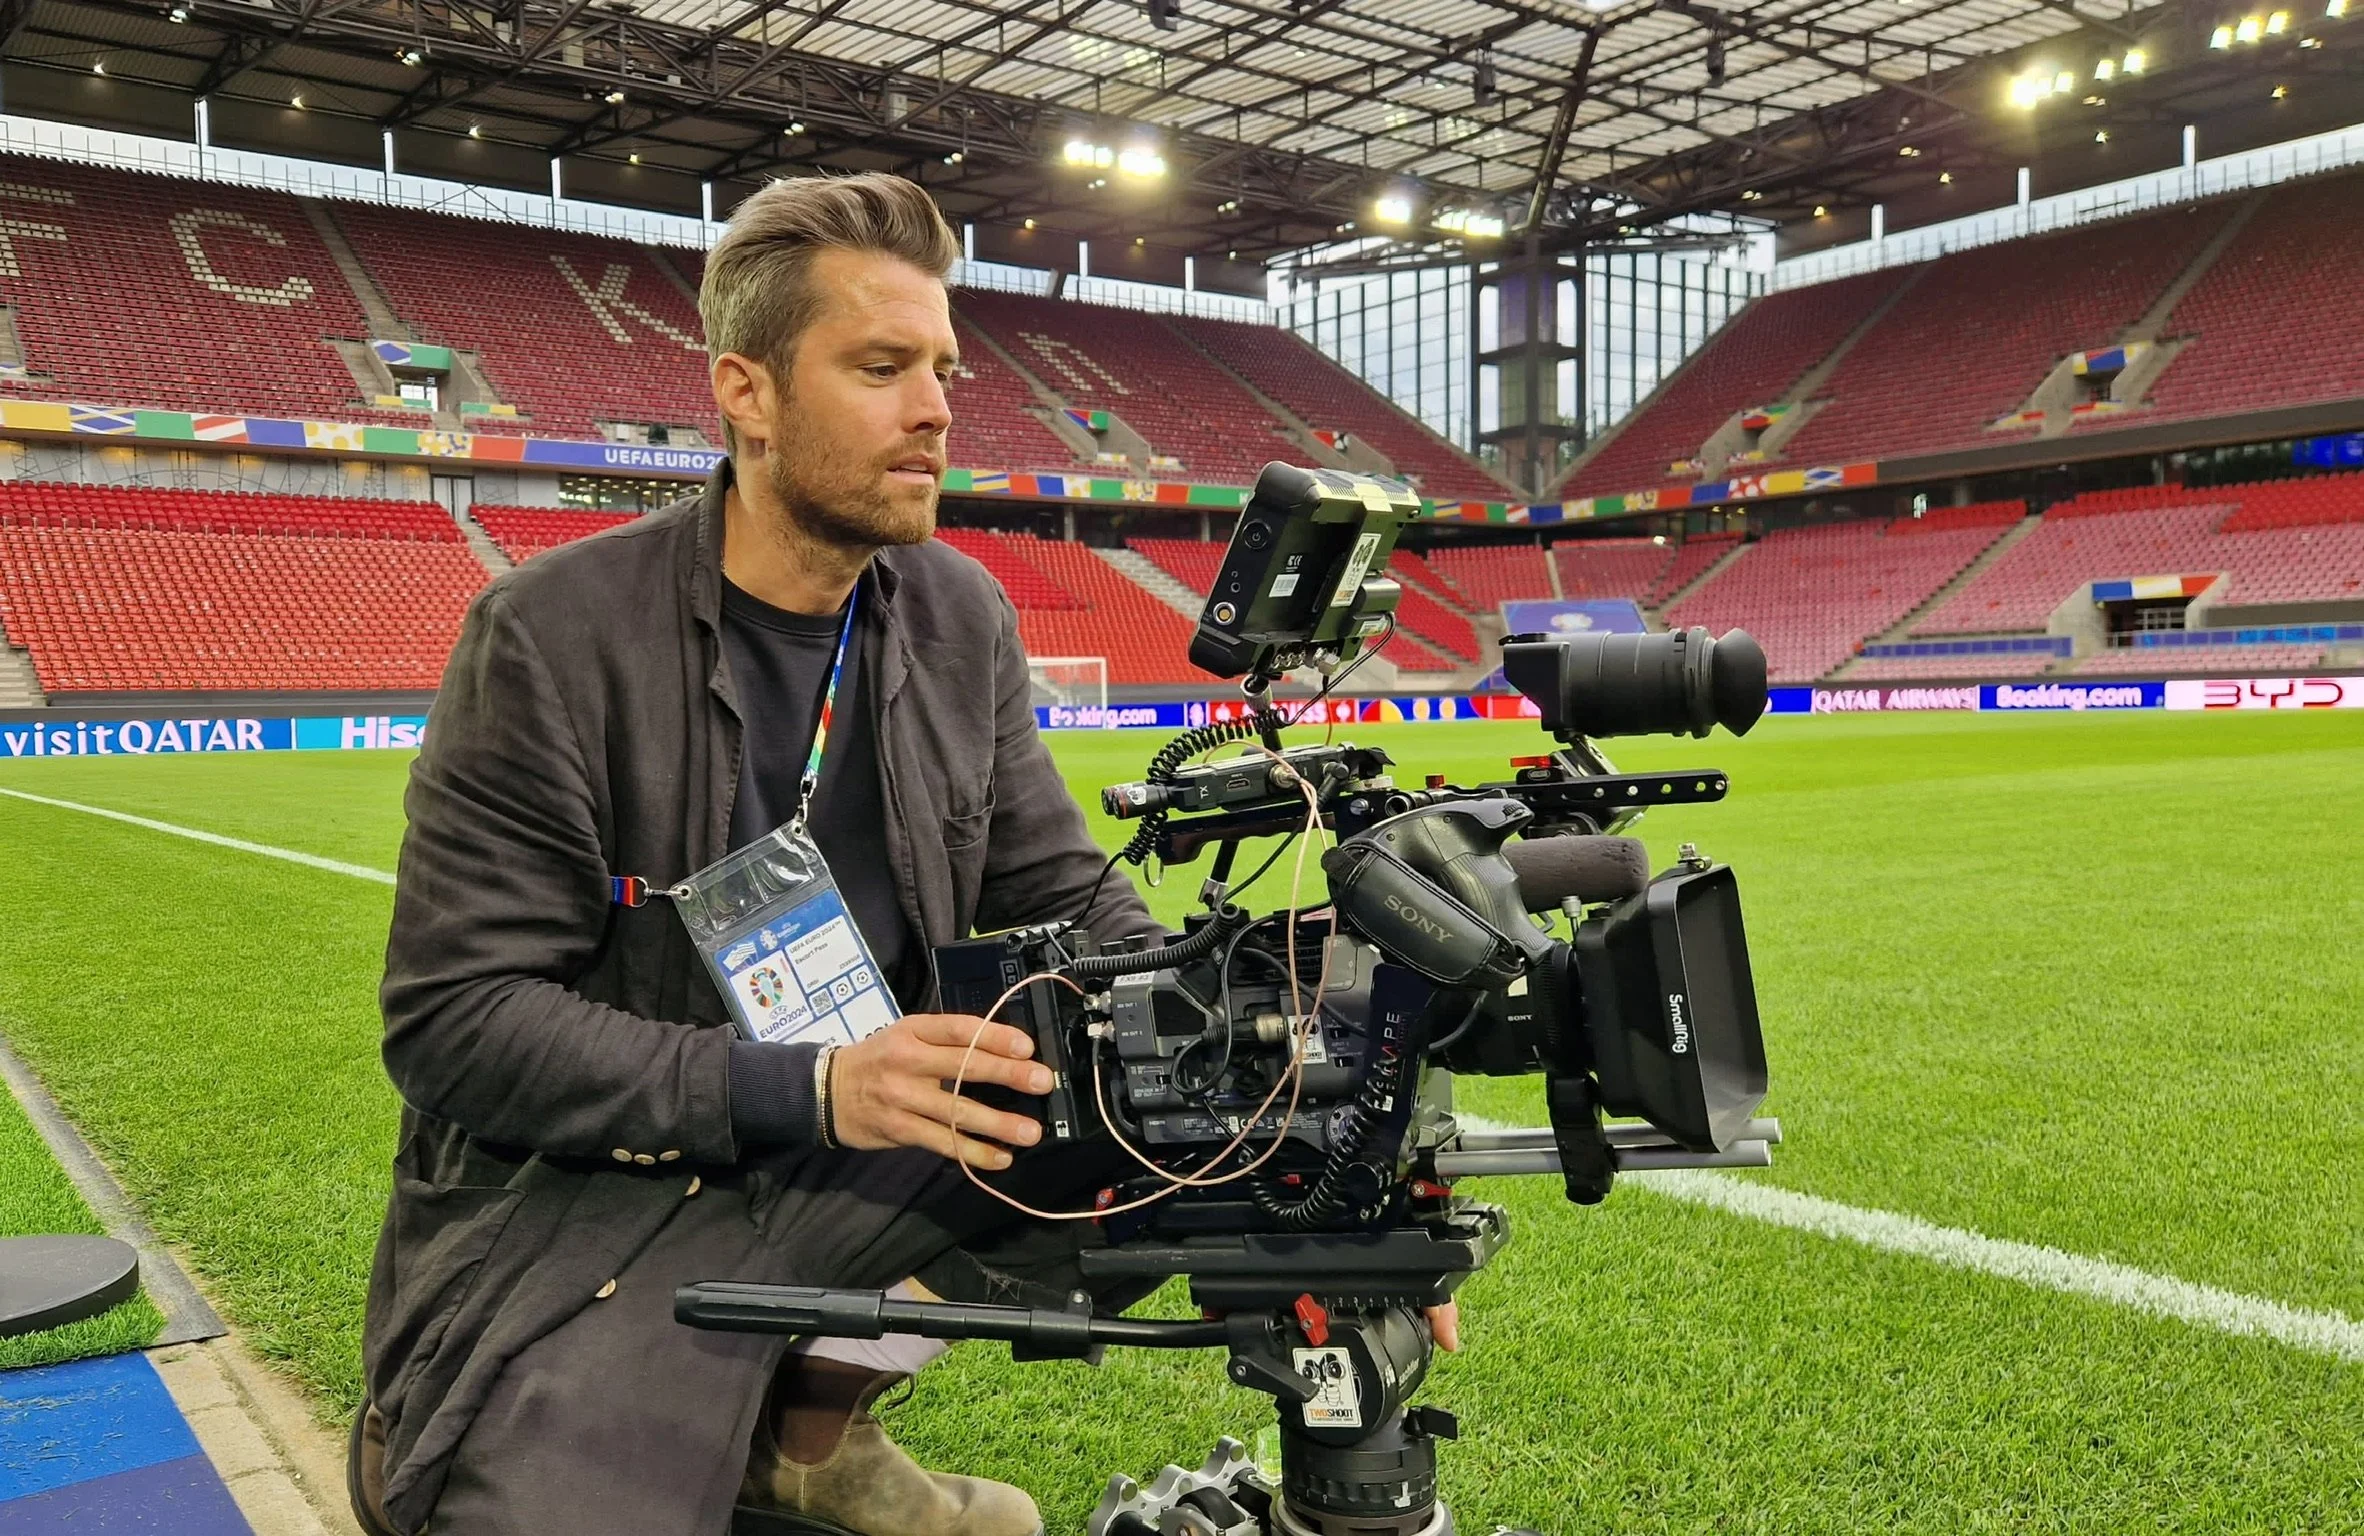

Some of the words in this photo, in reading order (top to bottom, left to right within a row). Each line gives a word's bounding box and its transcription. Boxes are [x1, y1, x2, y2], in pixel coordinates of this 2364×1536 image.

[1816, 690, 1881, 714] QATAR
[1996, 684, 2142, 710] Booking.com
[2204, 680, 2344, 709] BYD
[1383, 894, 1455, 944] SONY
[790, 942, 805, 954] UEFA
[804, 933, 821, 947] EURO
[759, 1005, 808, 1039] EURO2024
[1668, 993, 1688, 1054] SmallRig
